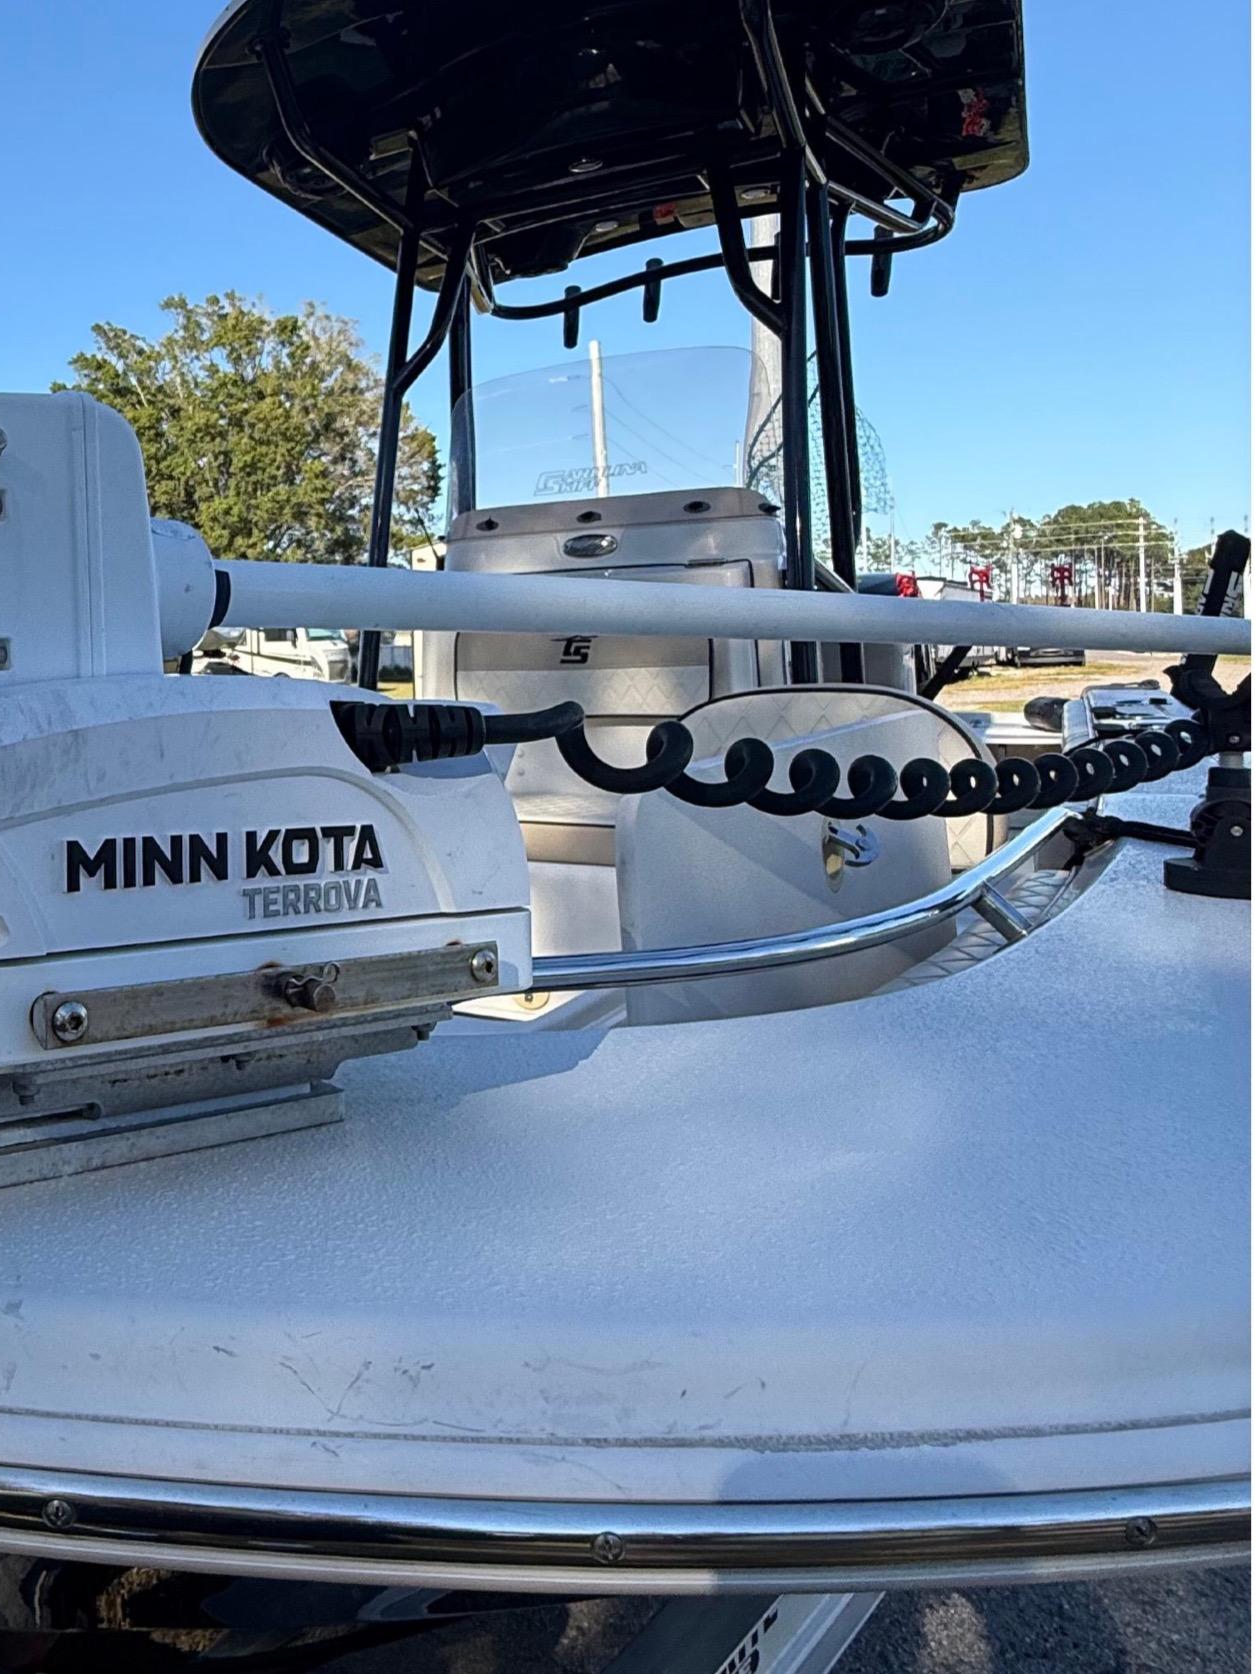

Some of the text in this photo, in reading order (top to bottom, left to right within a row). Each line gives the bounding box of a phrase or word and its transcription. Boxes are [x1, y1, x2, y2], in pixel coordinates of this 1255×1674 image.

[65, 824, 386, 893] MINN KOTA
[242, 878, 383, 919] TERROVA
